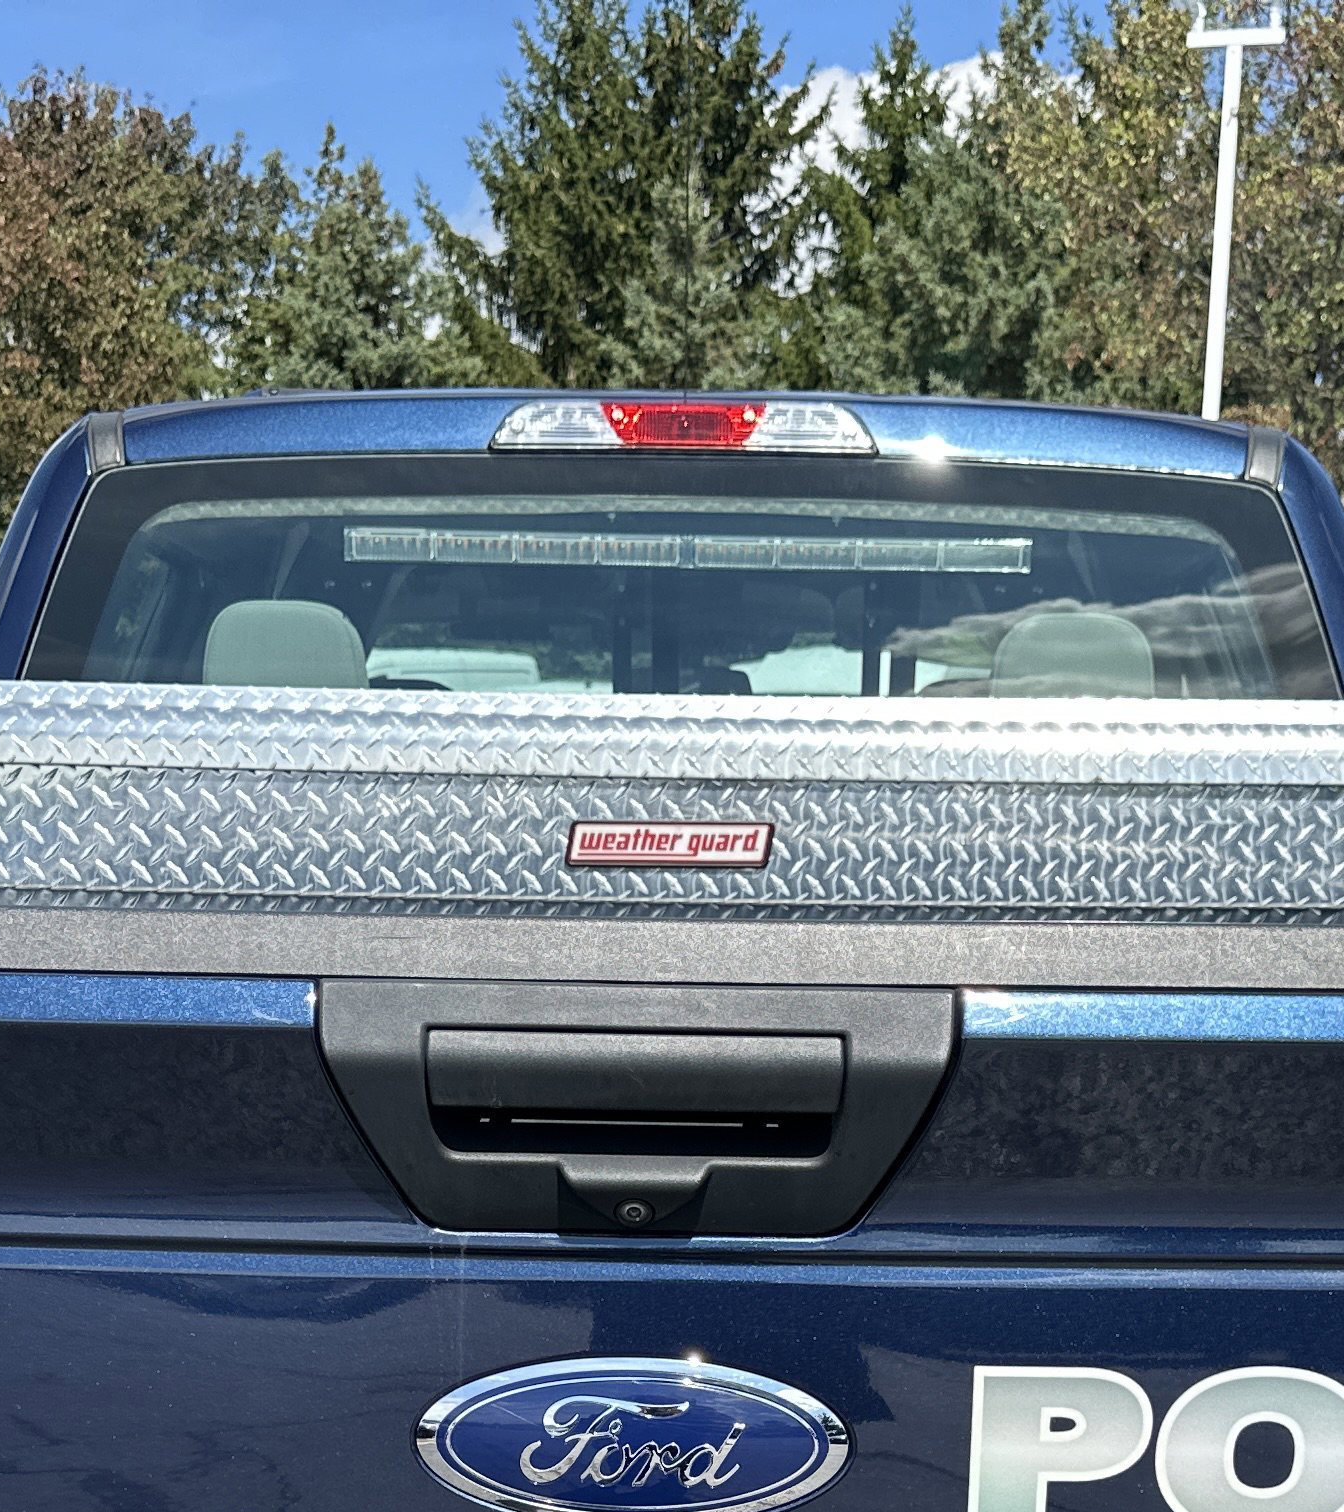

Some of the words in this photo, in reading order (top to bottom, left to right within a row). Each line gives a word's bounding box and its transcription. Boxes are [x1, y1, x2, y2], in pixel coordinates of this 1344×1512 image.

[578, 827, 683, 852] weather
[687, 828, 759, 856] guard
[520, 1395, 748, 1488] Ford
